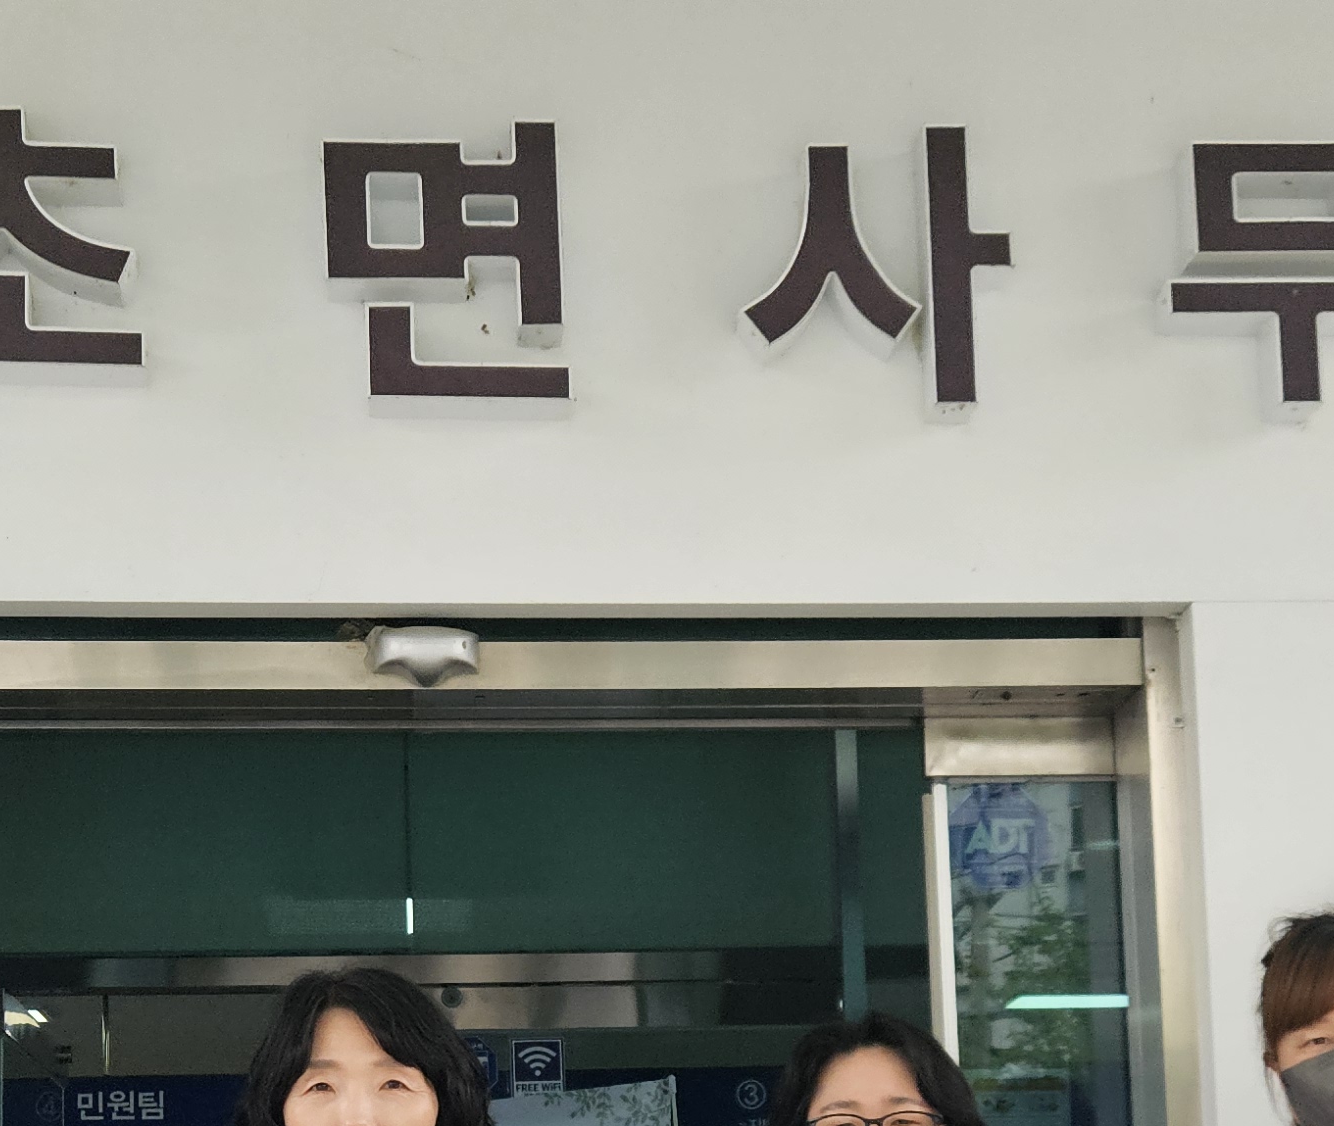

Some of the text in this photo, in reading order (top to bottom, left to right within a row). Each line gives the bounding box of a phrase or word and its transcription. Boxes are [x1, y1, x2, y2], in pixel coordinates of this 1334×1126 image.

[965, 819, 1036, 854] ADT
[516, 1083, 539, 1092] FREE
[76, 1089, 165, 1121] 민원팀
